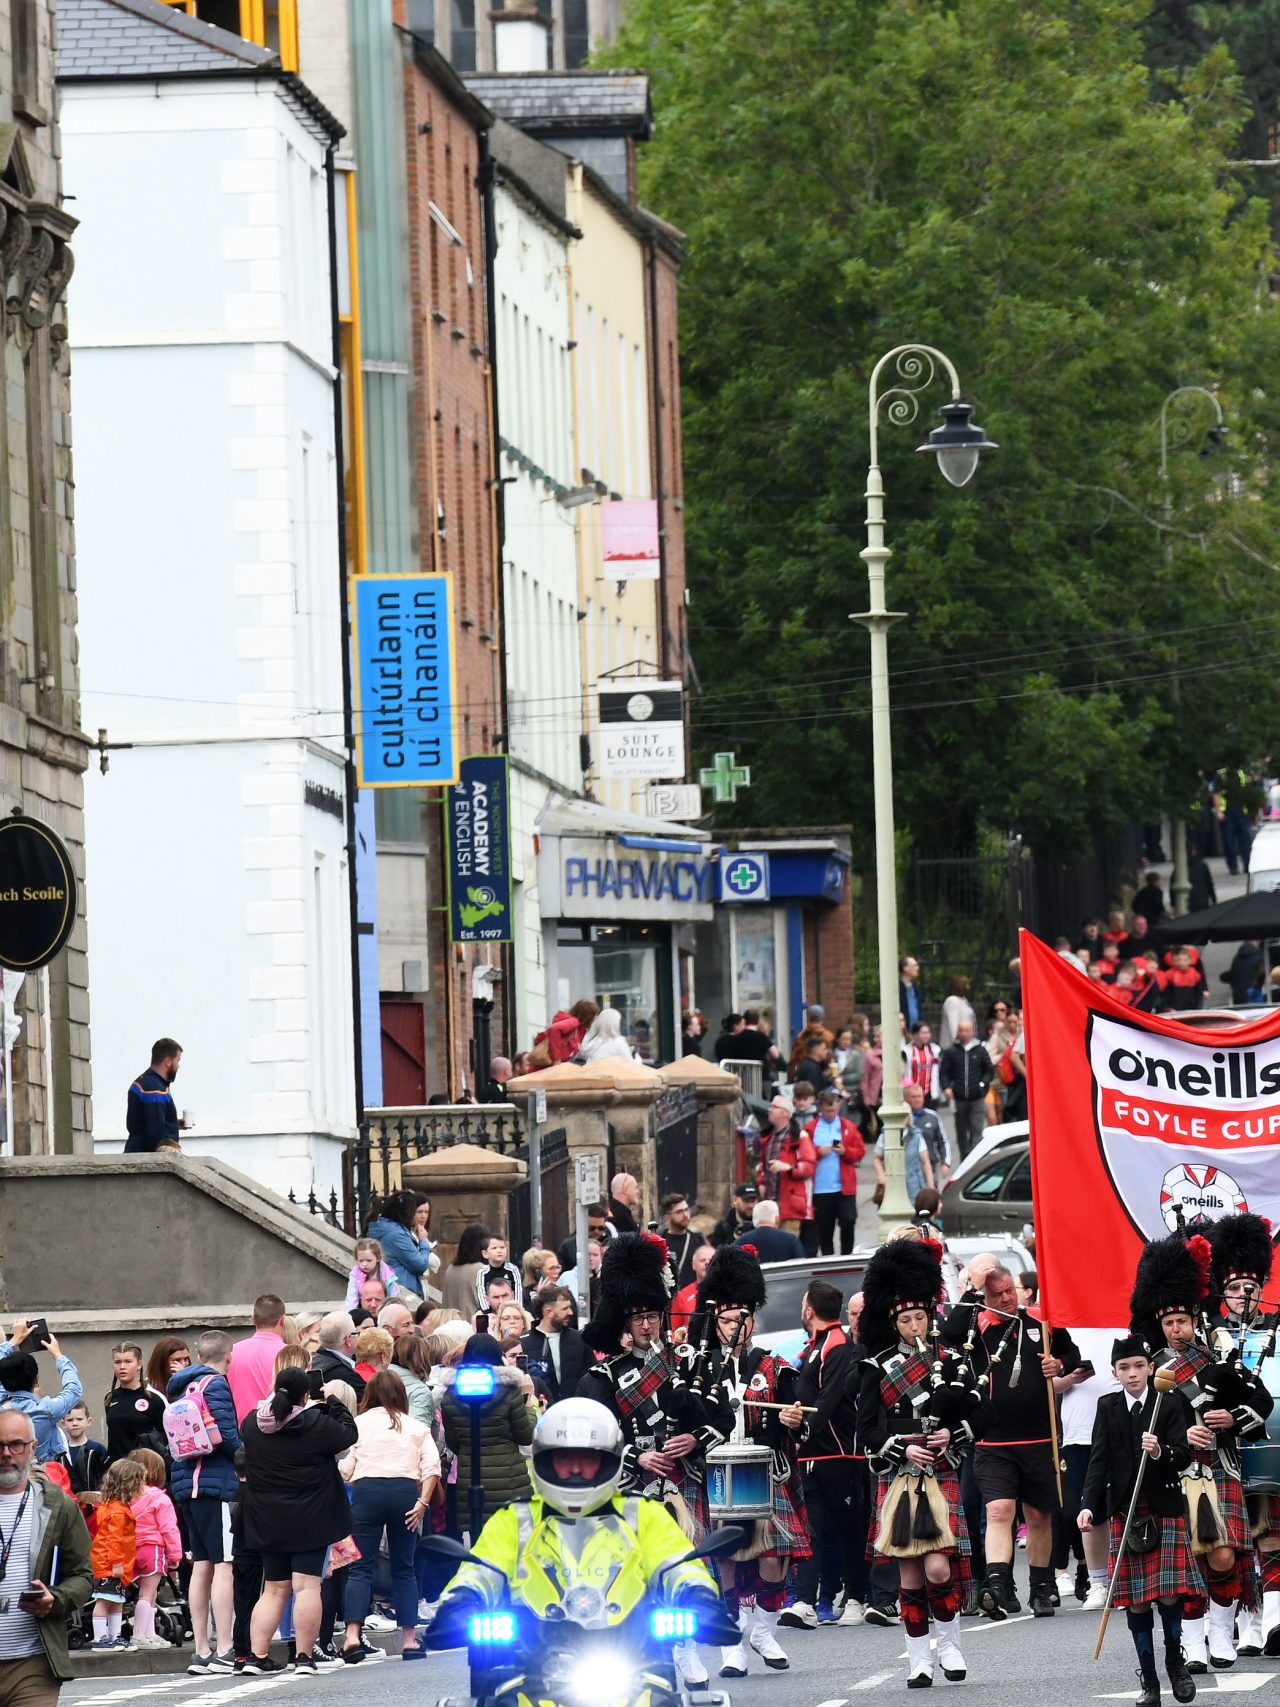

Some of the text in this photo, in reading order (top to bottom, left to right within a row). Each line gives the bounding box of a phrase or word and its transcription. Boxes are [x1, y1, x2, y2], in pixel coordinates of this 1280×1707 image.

[371, 592, 404, 768] cultúrlann
[405, 592, 441, 767] uí chanáin
[607, 745, 677, 760] LOUNGE
[622, 734, 659, 745] SUIT
[455, 800, 472, 876] ENGLISH
[472, 781, 490, 876] ACADEMY
[23, 886, 65, 901] Scoile
[566, 857, 711, 902] PHARMACY
[460, 929, 502, 940] Est. 1997
[1114, 1100, 1208, 1139] FOYLE
[556, 1430, 598, 1440] POE
